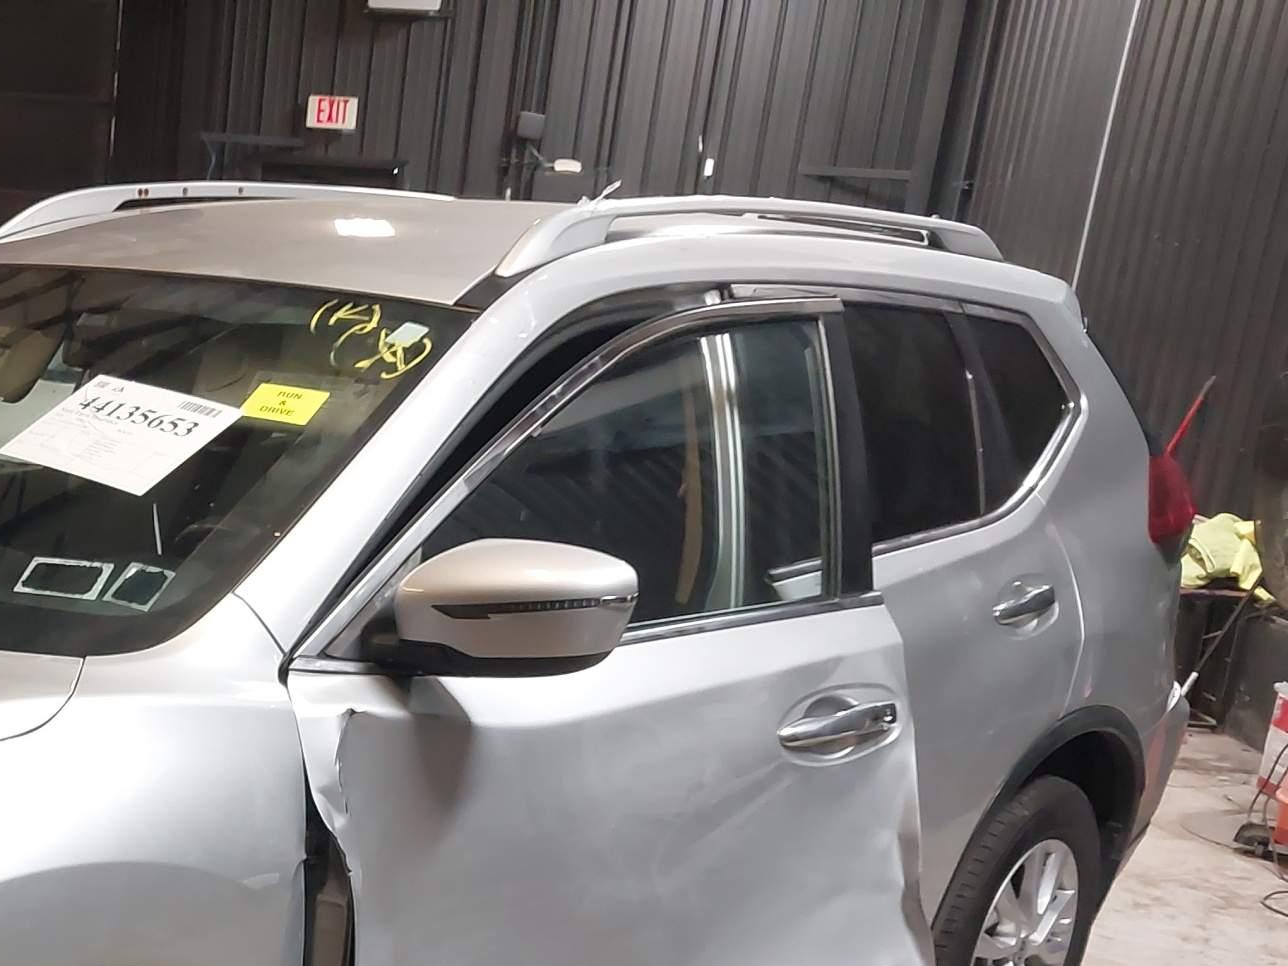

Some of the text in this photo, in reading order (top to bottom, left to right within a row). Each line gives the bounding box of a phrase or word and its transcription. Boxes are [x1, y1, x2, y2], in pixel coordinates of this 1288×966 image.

[316, 98, 349, 124] EXIT
[277, 391, 303, 400] RUN
[78, 396, 200, 437] 44135653
[259, 405, 295, 416] DRIVE
